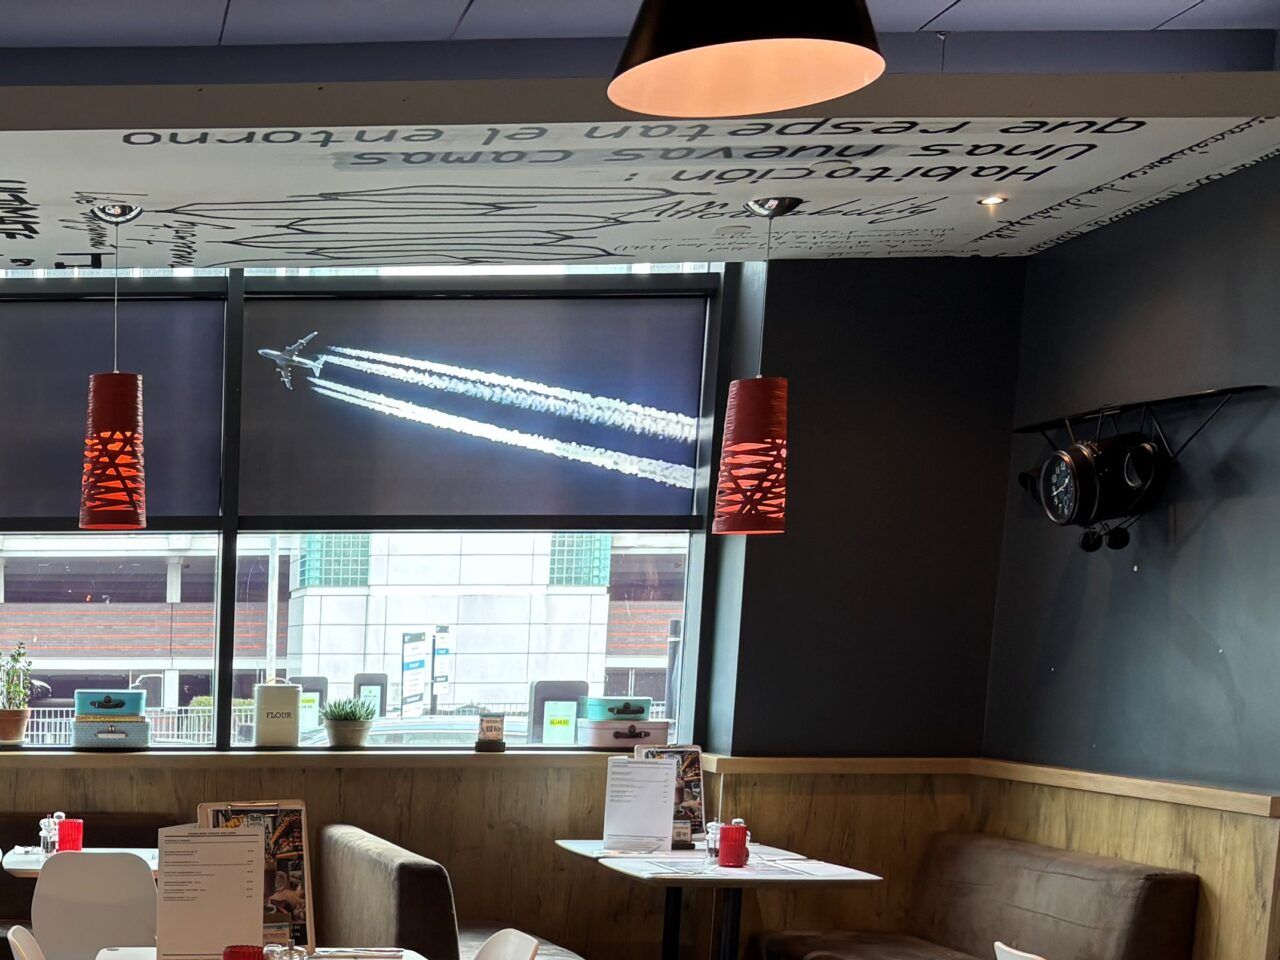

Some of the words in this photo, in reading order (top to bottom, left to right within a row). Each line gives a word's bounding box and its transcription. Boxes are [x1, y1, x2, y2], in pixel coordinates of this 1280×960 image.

[120, 128, 446, 147] entorno
[483, 127, 550, 145] el
[586, 117, 971, 142] respetan
[1000, 117, 1149, 139] que
[347, 150, 575, 166] camas
[609, 144, 883, 163] nuevas
[909, 142, 1098, 162] Unas
[266, 711, 293, 719] FLOUR
